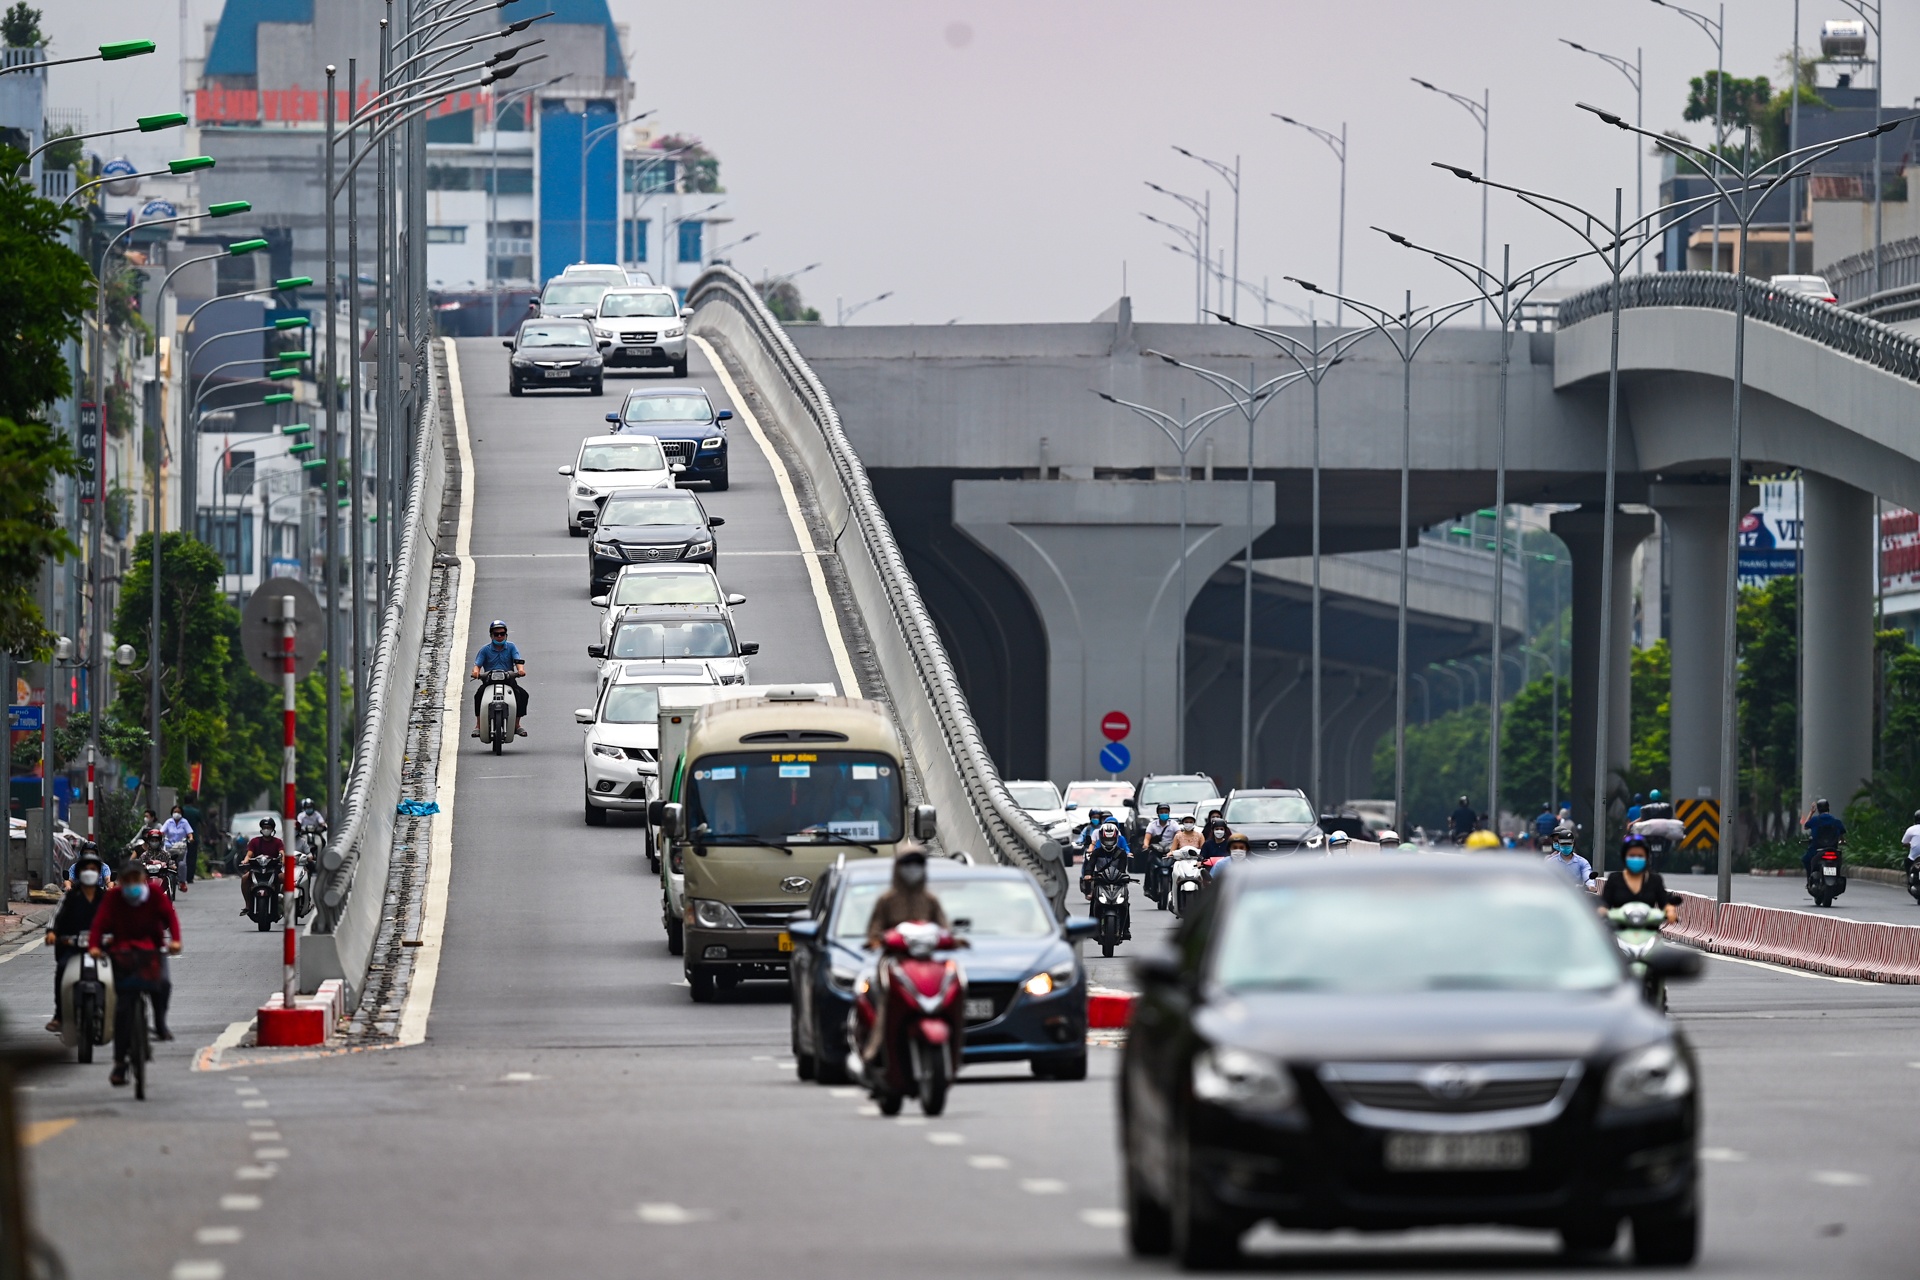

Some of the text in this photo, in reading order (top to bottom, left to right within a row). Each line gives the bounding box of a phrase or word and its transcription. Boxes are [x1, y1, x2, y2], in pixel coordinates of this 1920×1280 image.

[196, 82, 257, 126] BỆNH
[263, 84, 318, 127] VIỆN
[771, 754, 780, 762] XE
[782, 754, 796, 763] HỢP
